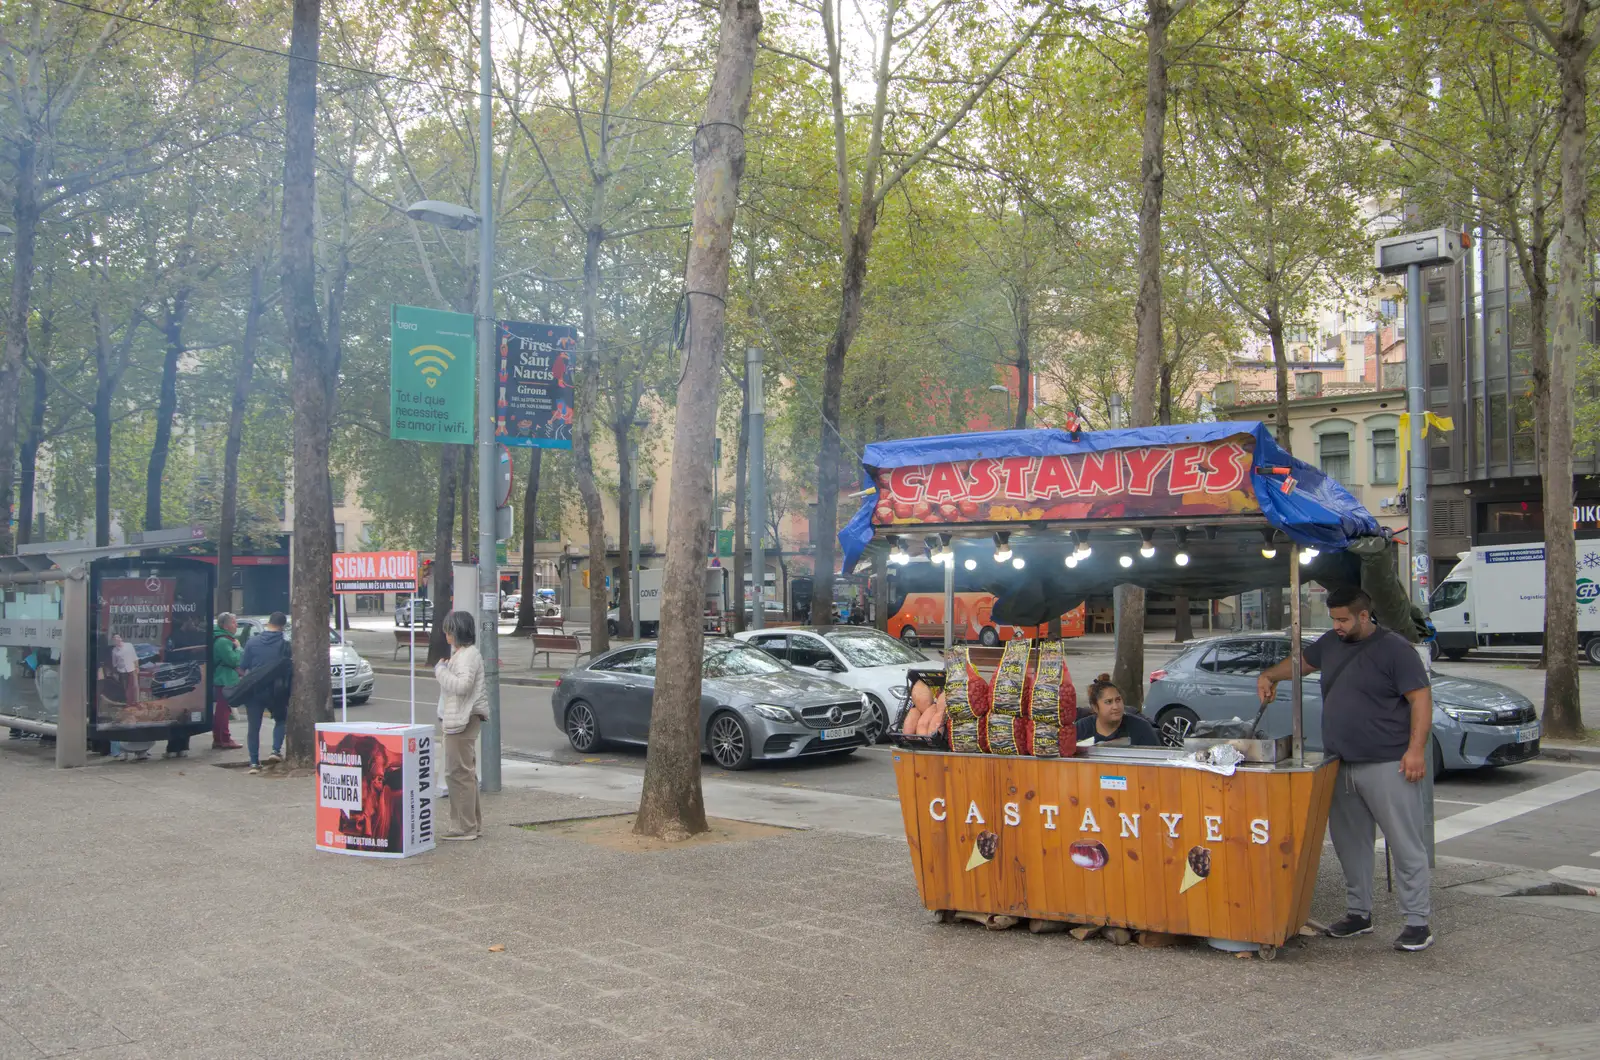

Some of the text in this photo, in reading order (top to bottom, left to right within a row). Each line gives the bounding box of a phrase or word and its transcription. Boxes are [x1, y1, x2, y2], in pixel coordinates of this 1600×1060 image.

[520, 337, 552, 352] Fires
[520, 352, 550, 367] Sant
[513, 366, 554, 381] Narcís
[517, 385, 547, 397] Girona
[396, 390, 446, 409] Tot el que
[396, 407, 449, 420] necessites
[396, 417, 468, 434] és amor i wifi.
[889, 442, 1247, 504] CASTANYES
[335, 551, 415, 580] SIGNA AQUÍ!
[109, 602, 196, 614] ET CONEIX COM NINGÚ
[320, 741, 328, 753] LA
[419, 736, 430, 793] SIGNA
[323, 773, 331, 786] NO
[341, 774, 359, 788] MEVA
[323, 786, 359, 802] CULTURA
[419, 797, 432, 844] AQUÍ!
[929, 797, 1271, 845] CASTANYES
